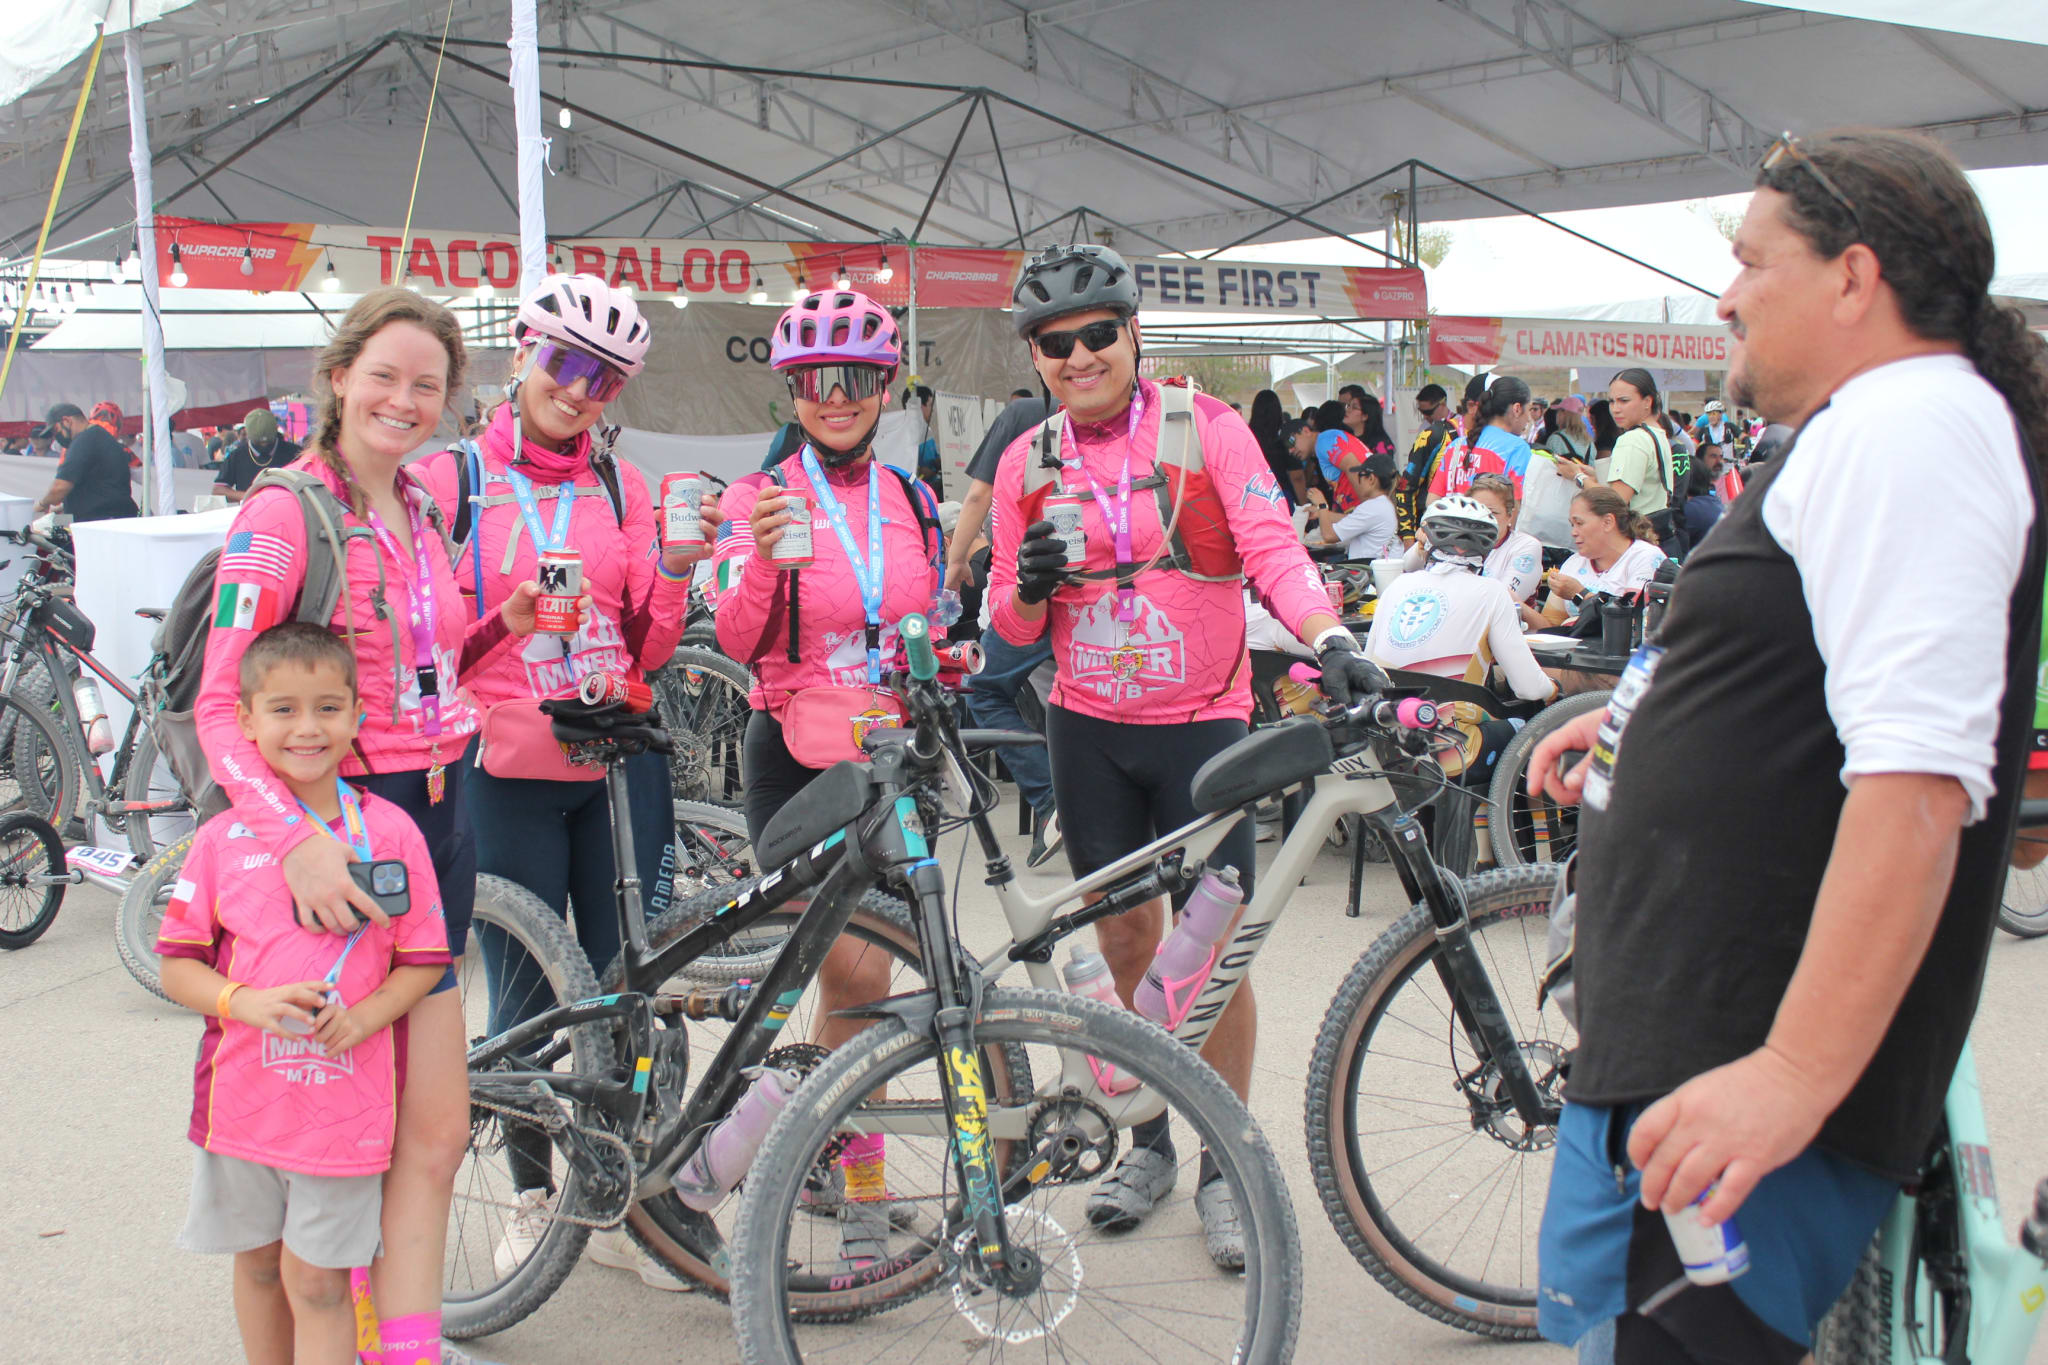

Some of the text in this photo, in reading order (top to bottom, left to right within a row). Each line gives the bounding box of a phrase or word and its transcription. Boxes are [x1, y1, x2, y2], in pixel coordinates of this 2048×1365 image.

[573, 246, 751, 294] BALOO
[926, 270, 1000, 283] CHUPACABRAS
[1134, 264, 1321, 309] FEE FIRST
[1516, 329, 1726, 361] CLAMATOS ROTARIOS
[1395, 492, 1412, 531] FOX
[535, 648, 627, 697] MINER
[150, 839, 193, 876] MAXXI
[736, 839, 828, 909] YEI
[829, 1274, 856, 1291] DT
[862, 1252, 913, 1286] SWISS
